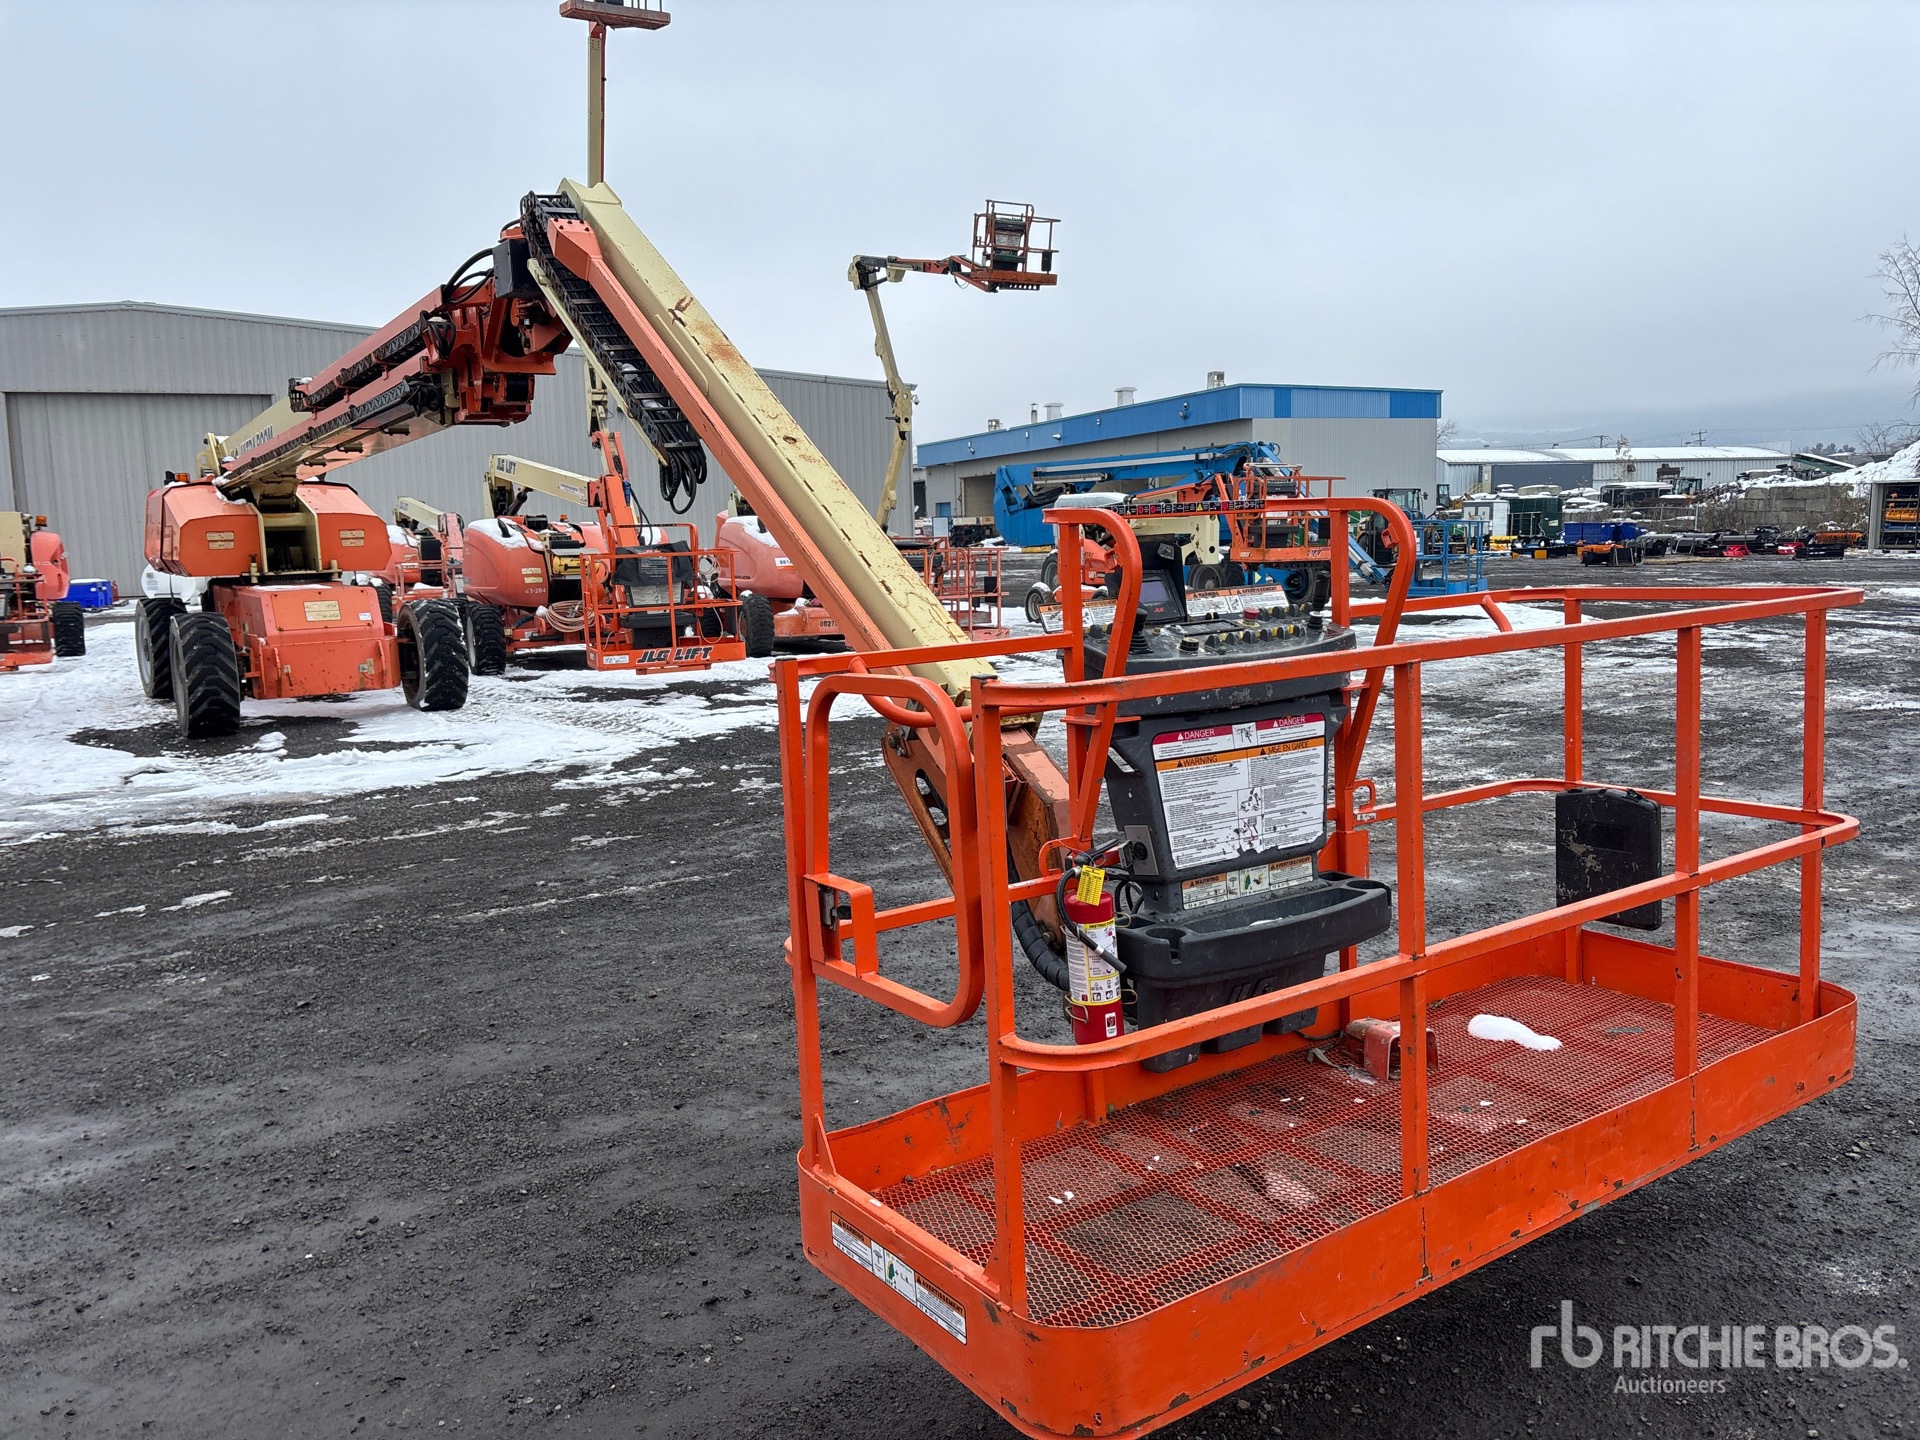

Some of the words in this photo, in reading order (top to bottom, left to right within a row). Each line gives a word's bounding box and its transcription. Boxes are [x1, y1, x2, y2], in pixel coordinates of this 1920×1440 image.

[505, 460, 517, 476] LIFT
[635, 647, 671, 665] JLG
[672, 645, 714, 662] LIFT
[1278, 716, 1306, 728] DANGER
[1184, 728, 1216, 740] DANGER
[1282, 743, 1291, 753] EN
[1291, 740, 1310, 752] GARDE
[1183, 754, 1218, 768] WARNING
[1194, 875, 1220, 887] WARNING
[841, 1221, 866, 1243] WARNING
[920, 1279, 964, 1314] AVERTISSEMENT
